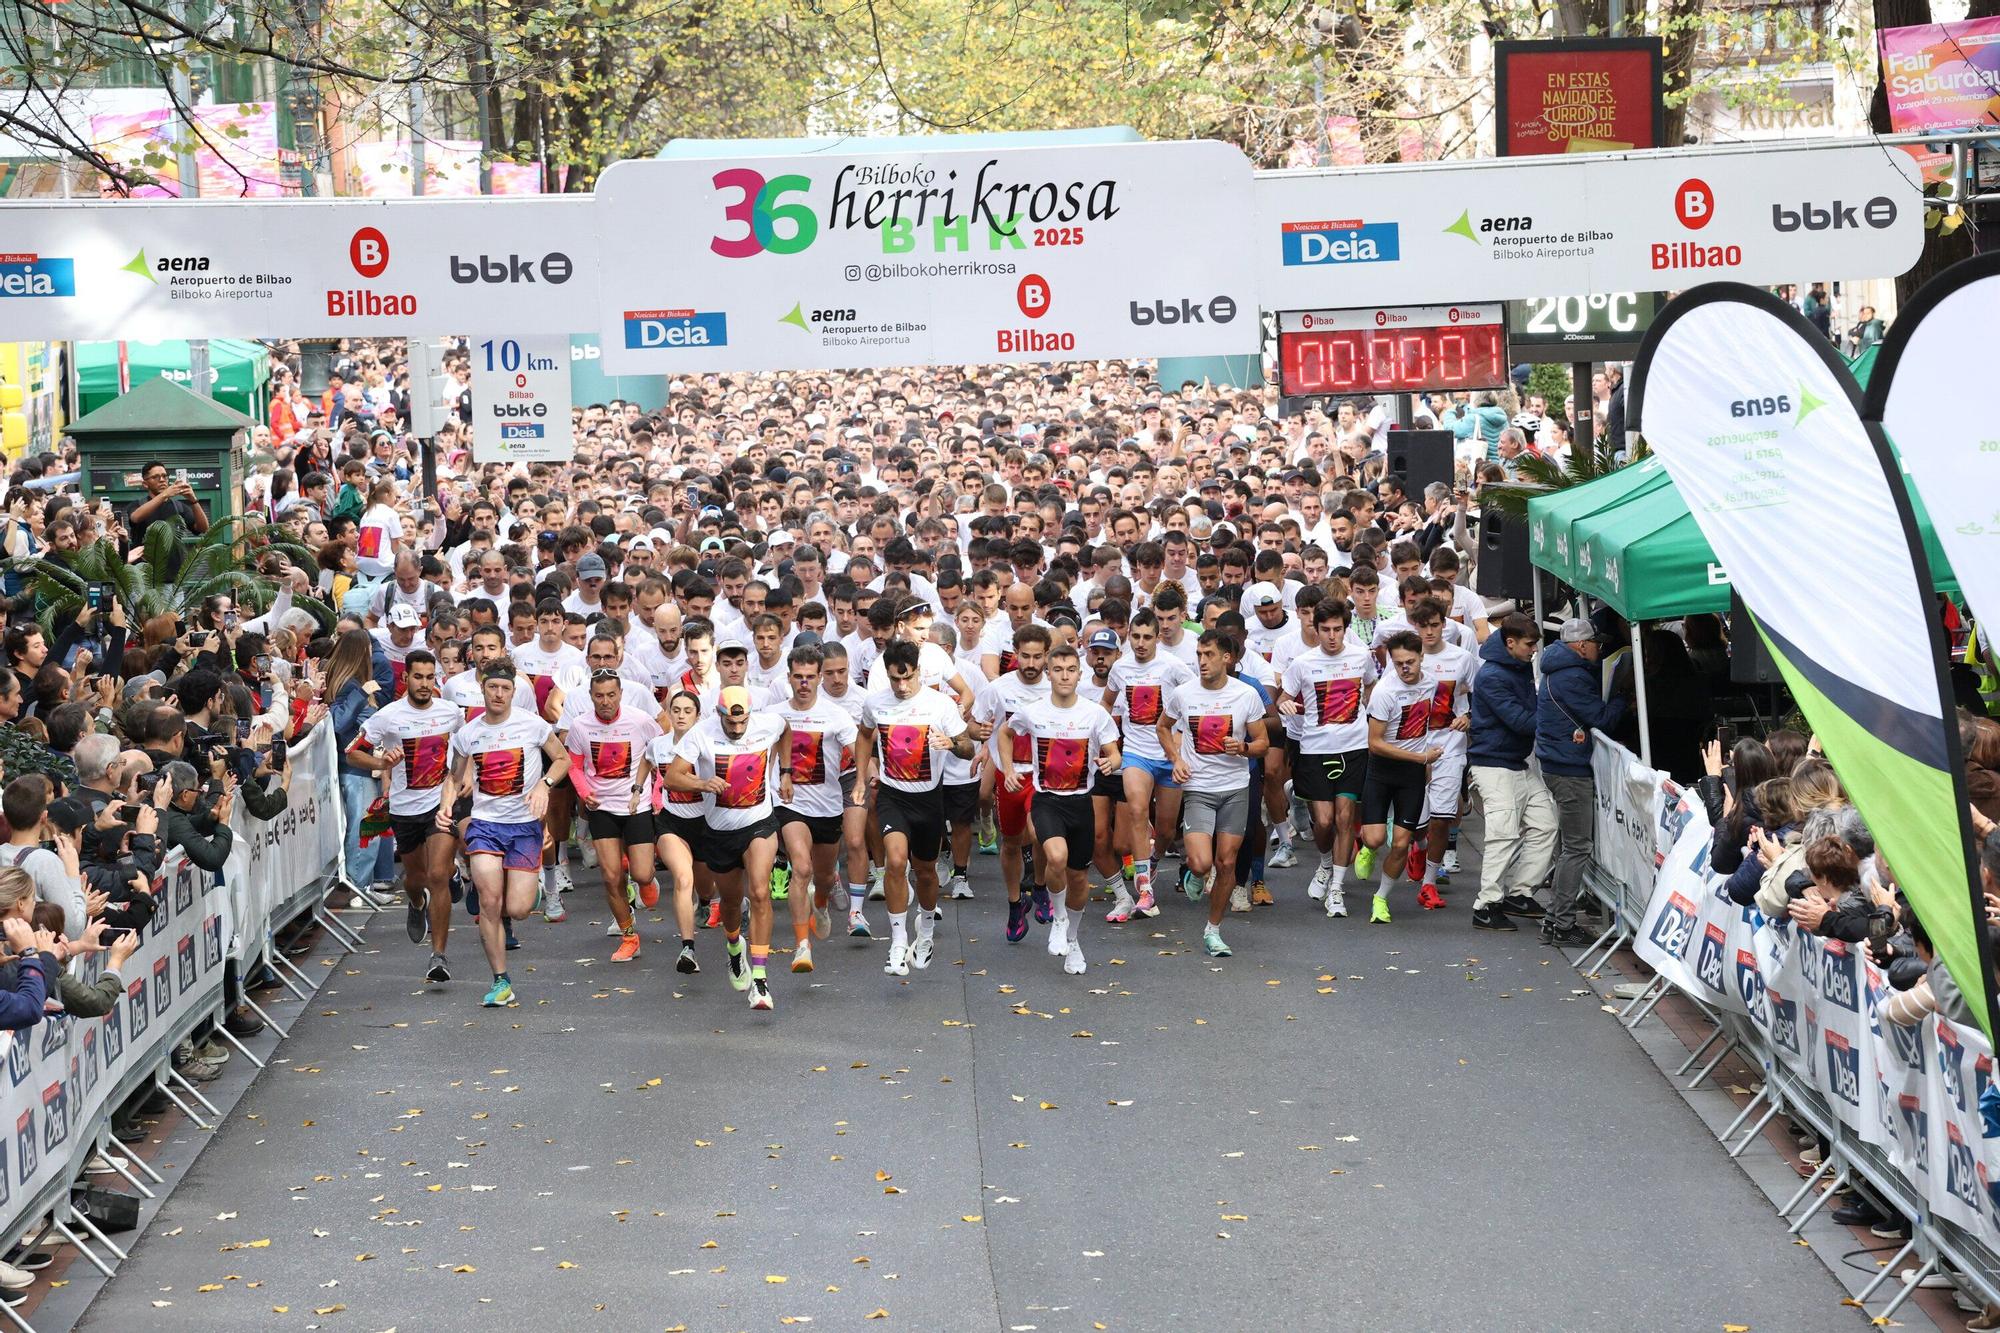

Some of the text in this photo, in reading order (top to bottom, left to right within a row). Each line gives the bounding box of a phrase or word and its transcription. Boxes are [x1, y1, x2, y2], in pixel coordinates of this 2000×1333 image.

[1888, 51, 1934, 75] Fair
[1548, 72, 1610, 88] EN ESTAS
[1543, 90, 1616, 105] NAVIDADES.
[1896, 93, 1989, 111] Azaroak 29 noviembre
[1599, 106, 1616, 120] DE
[1548, 123, 1616, 141] SUCHARD.
[855, 162, 935, 188] Bilboko
[710, 168, 818, 259] 36
[1772, 201, 1860, 232] bbk
[1321, 222, 1329, 230] de
[1480, 216, 1533, 232] aena
[1034, 227, 1084, 247] 2025
[1493, 231, 1614, 247] Aeropuerto de Bilbao
[1301, 232, 1379, 263] Deia
[1493, 246, 1595, 260] Bilboko Aireportua
[1651, 242, 1742, 270] Bilbao
[157, 256, 210, 272] aena
[450, 254, 536, 284] bbk
[865, 261, 1017, 282] @bilbokoherrikrosa
[0, 265, 55, 295] eia
[170, 274, 292, 287] Aeropuerto de Bilbao
[171, 289, 273, 301] Bilboko Aireportua
[326, 290, 417, 316] Bilbao
[811, 308, 857, 323] aena
[1130, 298, 1205, 326] bbk
[1526, 291, 1637, 333] 20°C
[640, 320, 710, 347] Deia
[822, 323, 927, 335] Aeropuerto de Bilbao
[1563, 333, 1595, 341] JCDecaux
[823, 335, 911, 346] Bilboko Aireportua
[997, 329, 1075, 352] Bilbao
[481, 339, 558, 372] 10 km.
[571, 344, 600, 361] bb
[1298, 335, 1497, 386] 00:00:01
[509, 391, 534, 399] Bilbao
[493, 404, 530, 417] bbk
[508, 426, 537, 438] Deia
[1825, 956, 1852, 1006] Deia
